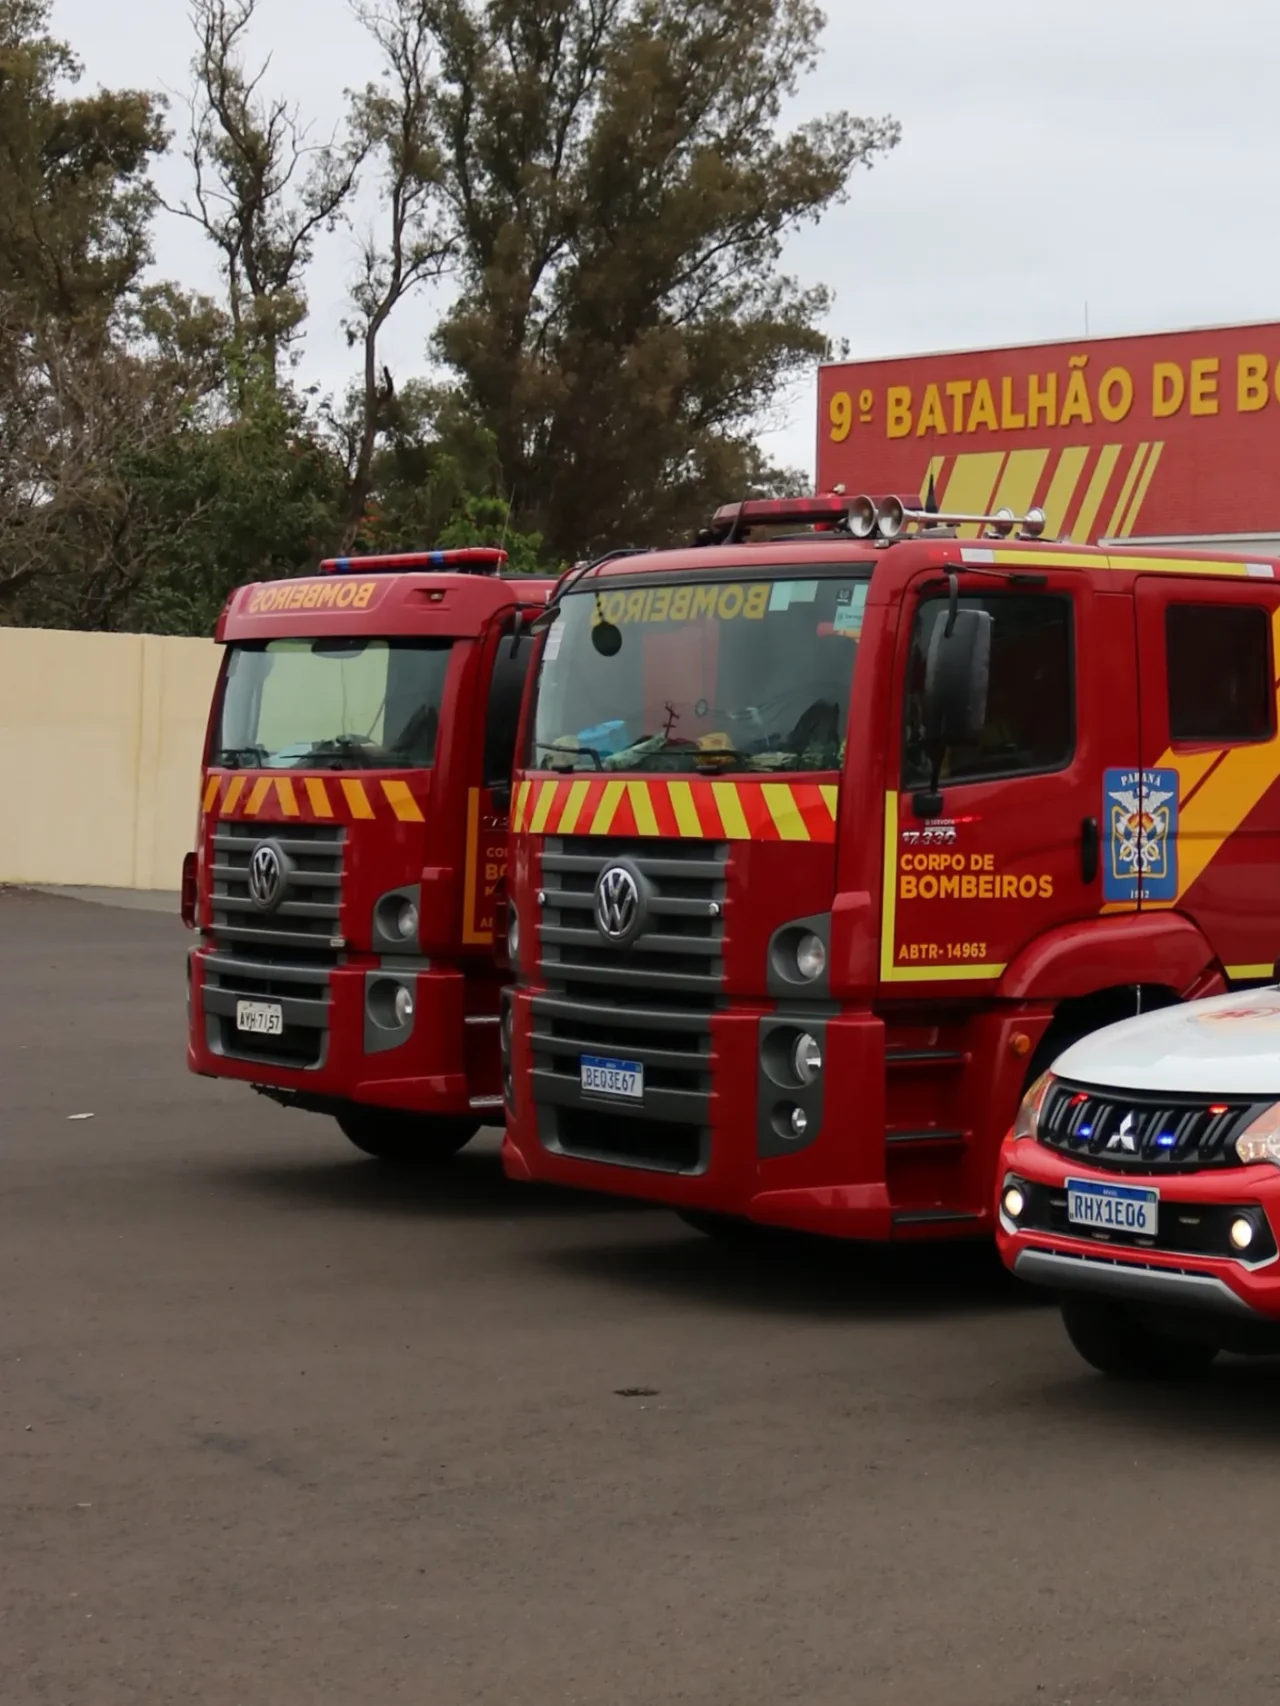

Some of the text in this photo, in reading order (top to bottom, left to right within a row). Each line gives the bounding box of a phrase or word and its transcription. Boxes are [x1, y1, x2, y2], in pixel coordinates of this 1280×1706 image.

[829, 388, 873, 442] 9º
[887, 355, 1134, 440] BATALHÃO
[1152, 357, 1220, 418] DE
[900, 853, 994, 871] CORPO DE
[900, 874, 1054, 899] BOMBEIROS
[1075, 1195, 1147, 1229] RHX1E06
